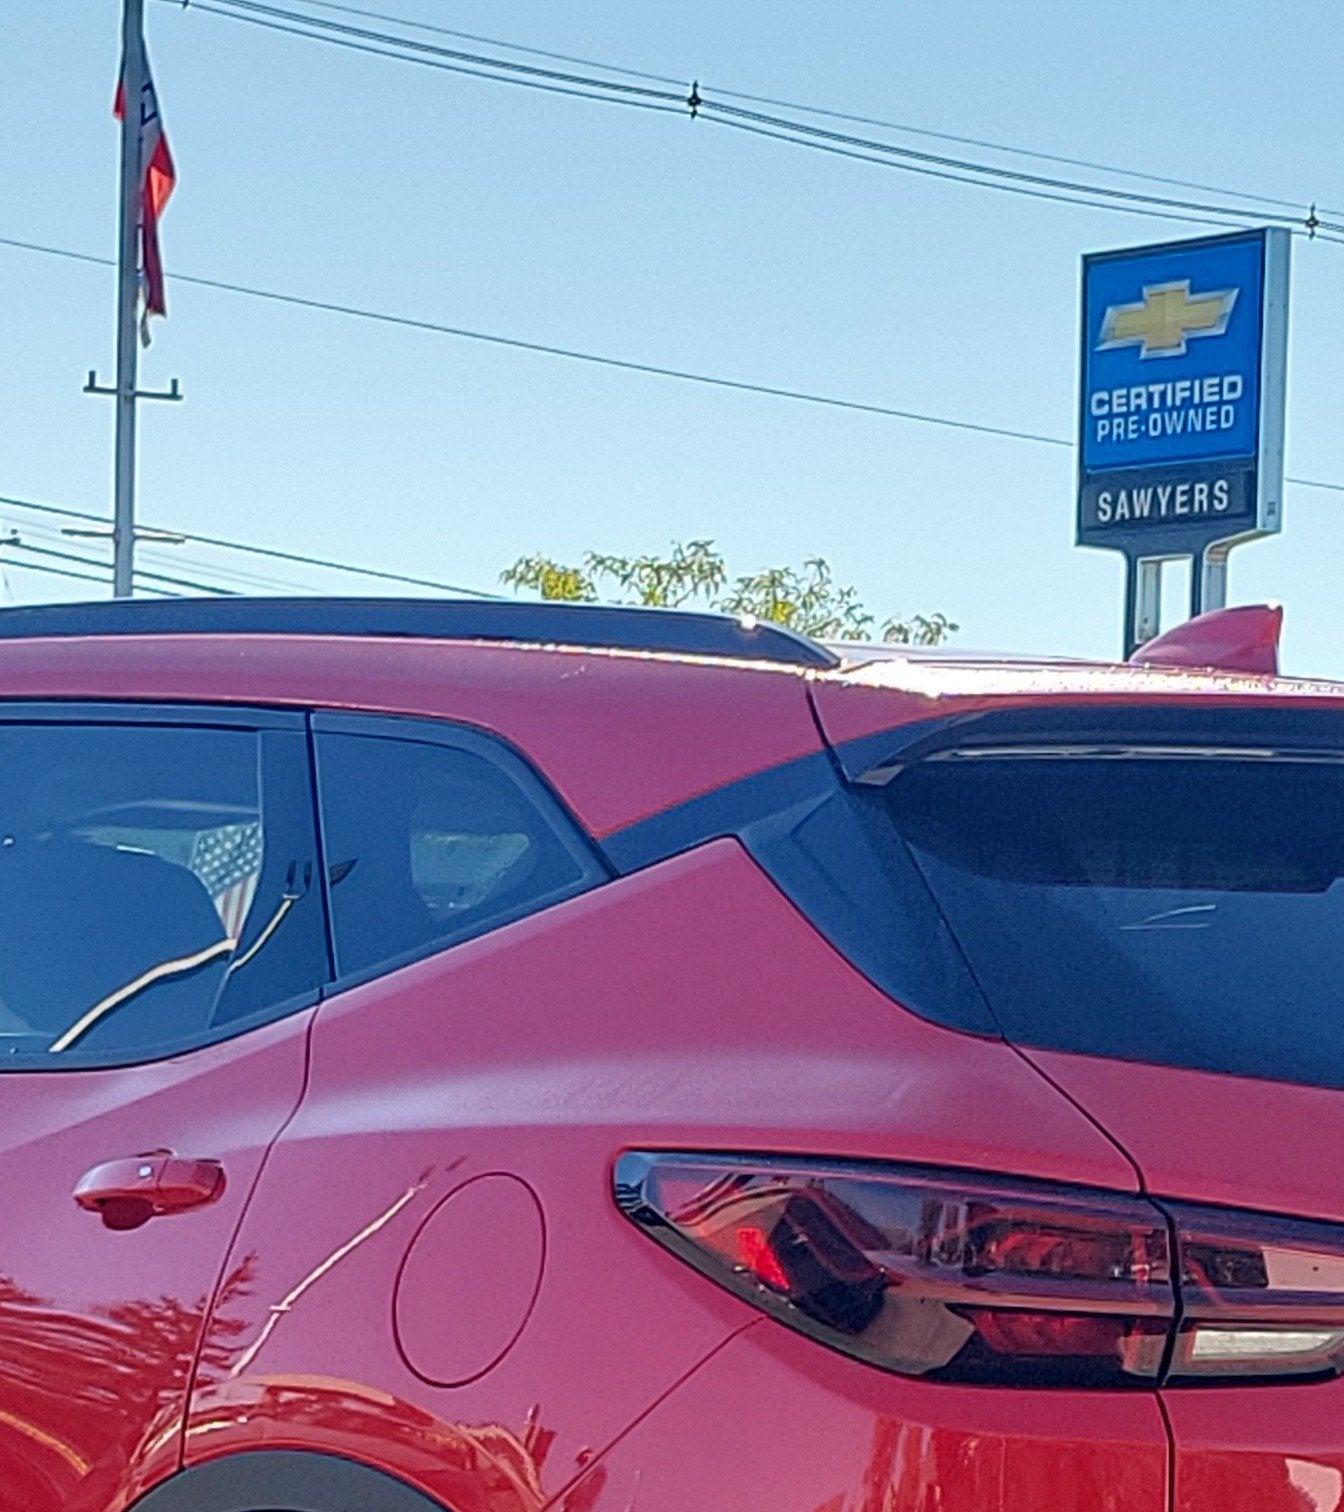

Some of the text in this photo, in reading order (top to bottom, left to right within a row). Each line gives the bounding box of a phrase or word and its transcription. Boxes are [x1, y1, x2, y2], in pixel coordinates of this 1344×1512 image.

[1091, 375, 1243, 416] CERTIFIED
[1097, 405, 1234, 442] PRE-OWNED
[1097, 479, 1229, 522] SAWYERS
